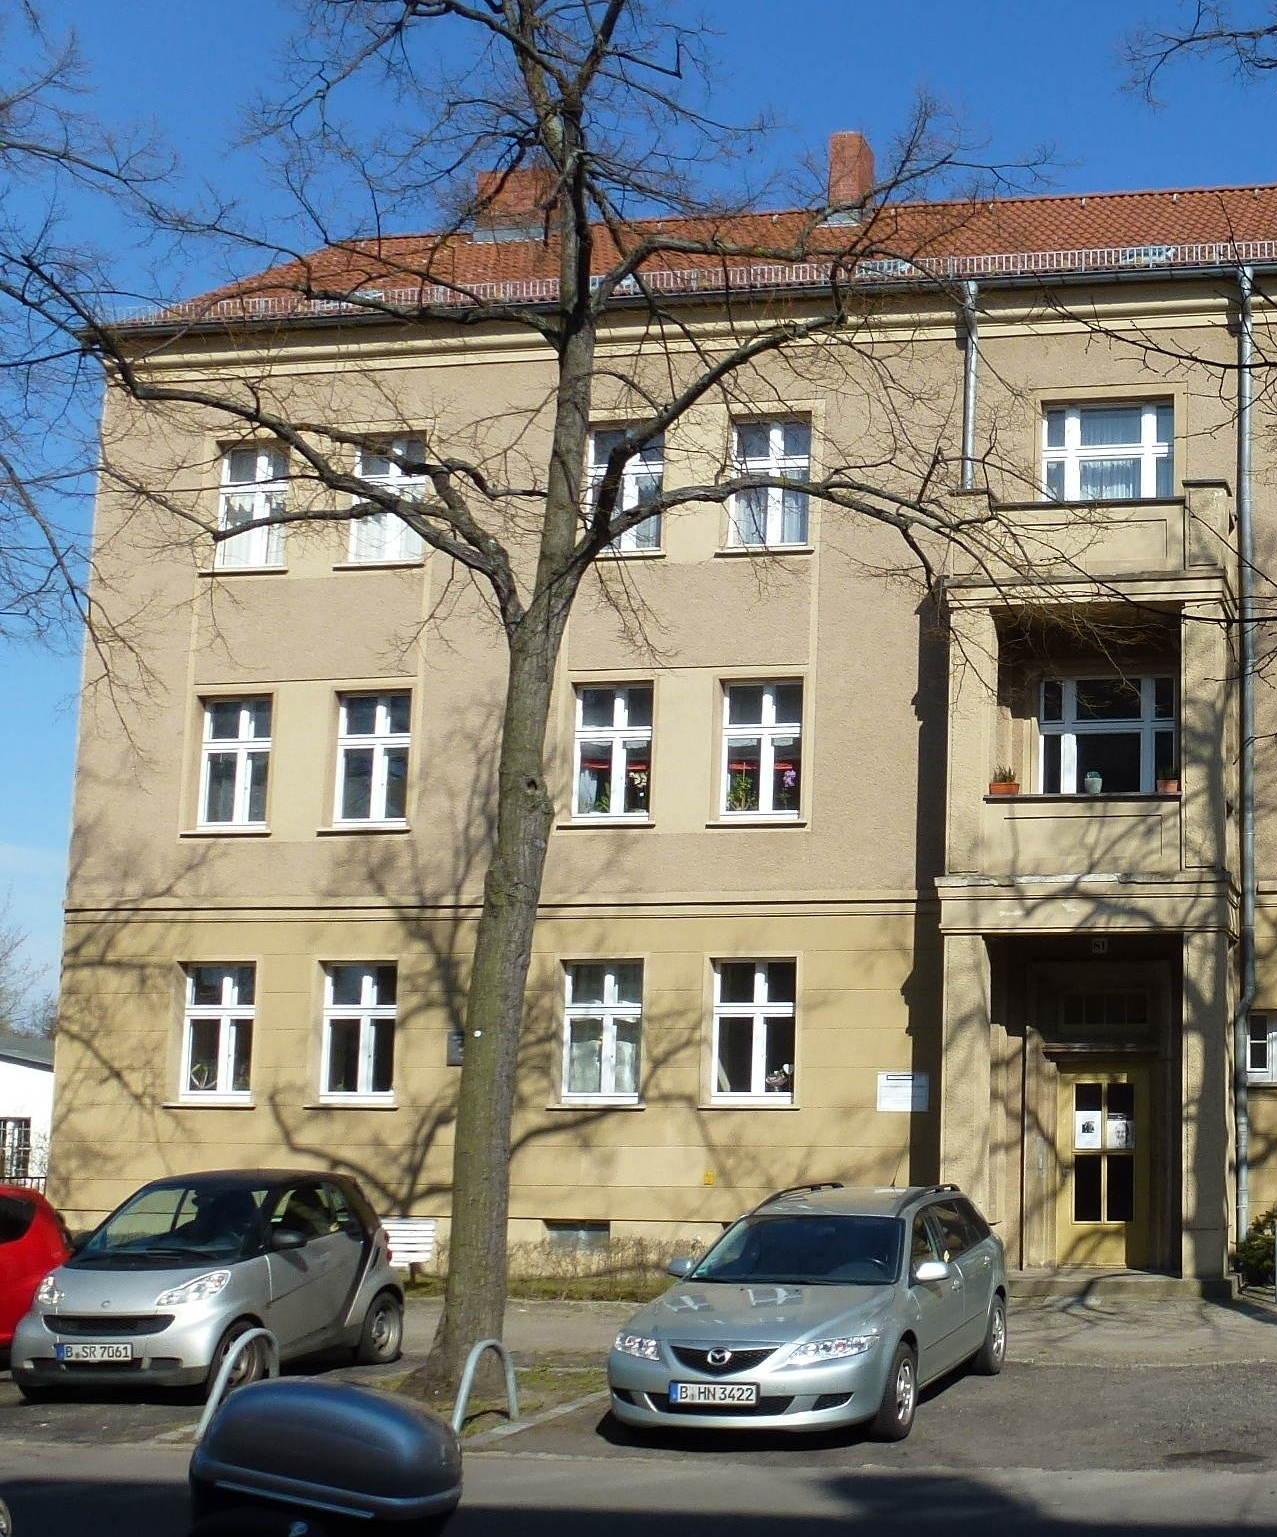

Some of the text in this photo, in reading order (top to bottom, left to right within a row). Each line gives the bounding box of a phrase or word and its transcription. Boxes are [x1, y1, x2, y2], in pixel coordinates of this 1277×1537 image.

[65, 1345, 130, 1359] B SR 7061
[680, 1385, 754, 1402] B HN 3422
